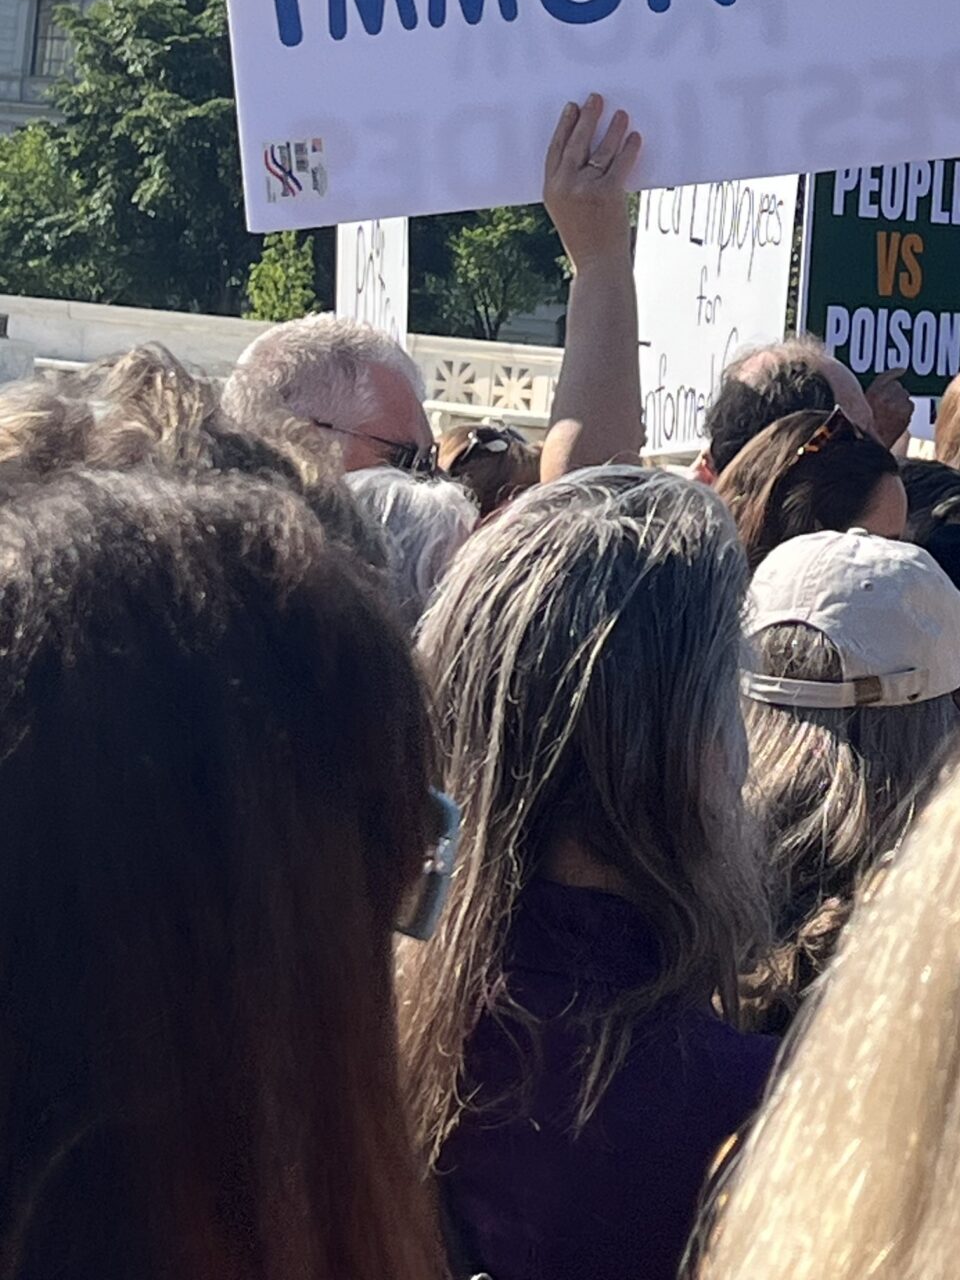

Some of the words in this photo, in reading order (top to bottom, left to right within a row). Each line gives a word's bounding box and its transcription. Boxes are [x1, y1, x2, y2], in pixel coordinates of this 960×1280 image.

[697, 265, 721, 326] for
[876, 231, 924, 298] VS
[640, 340, 715, 450] nformed
